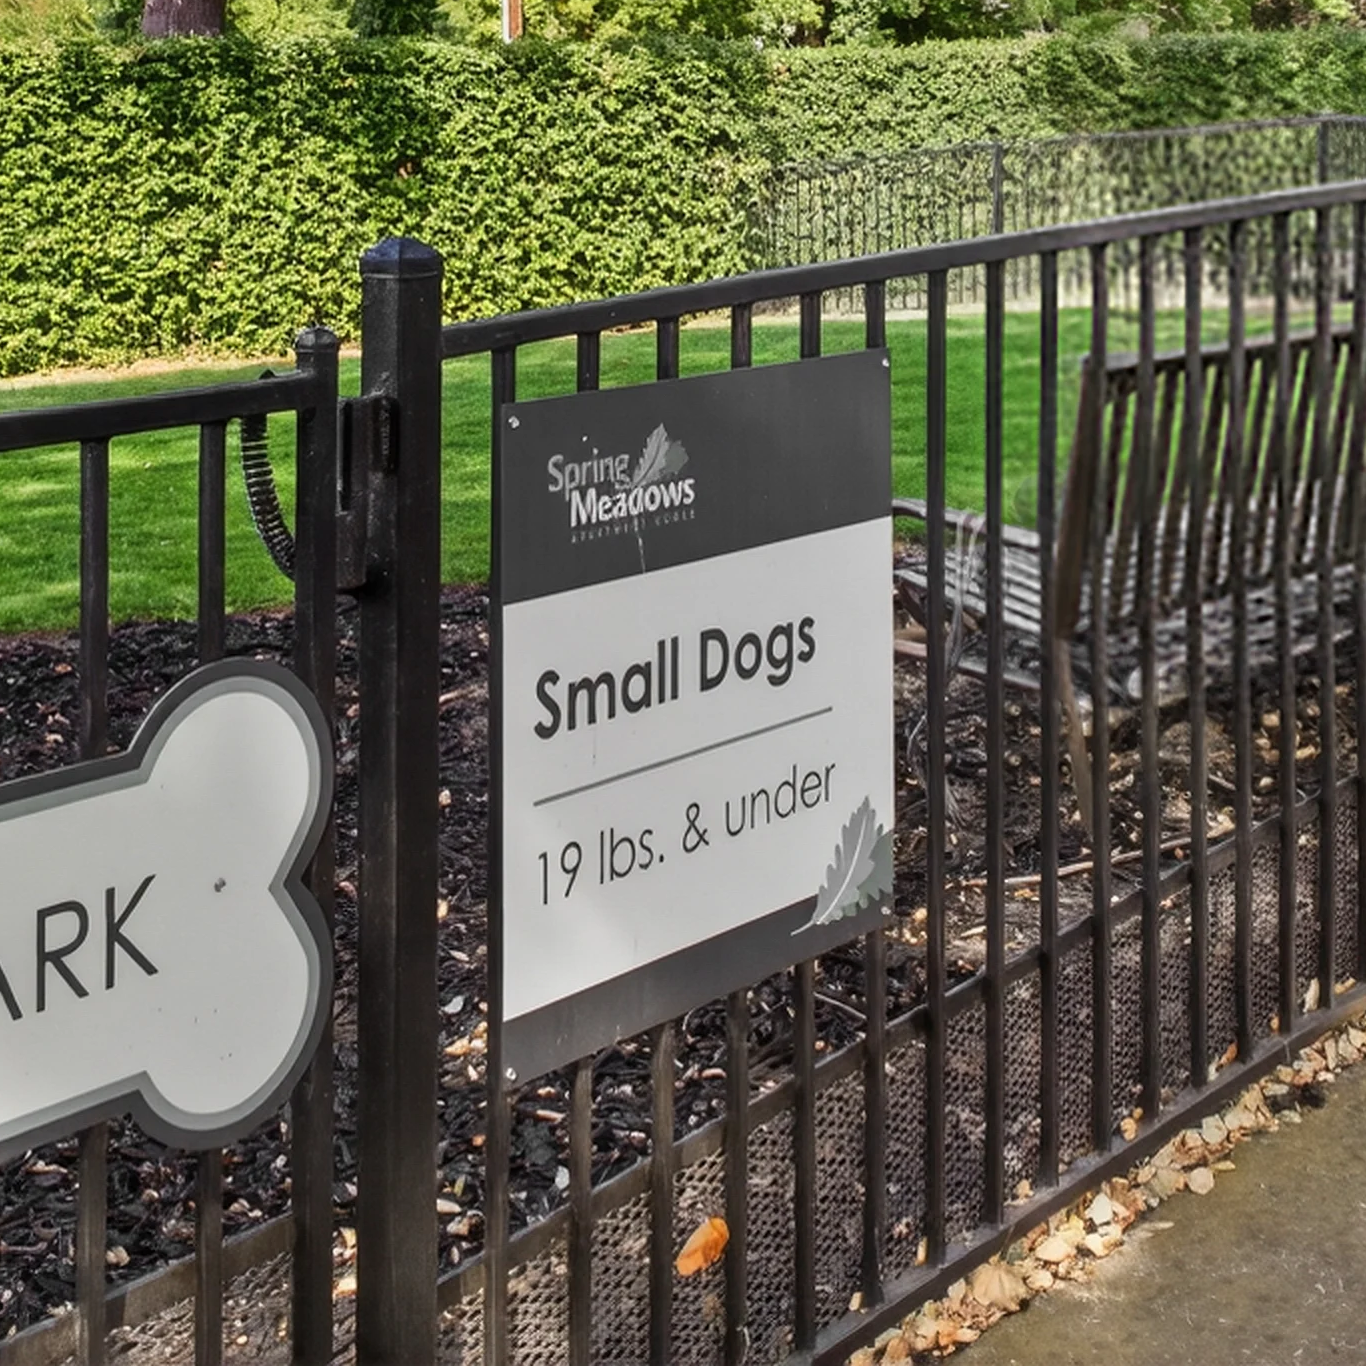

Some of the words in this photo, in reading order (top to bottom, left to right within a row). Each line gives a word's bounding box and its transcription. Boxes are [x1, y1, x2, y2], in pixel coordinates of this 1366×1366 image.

[547, 447, 633, 501] Spring
[570, 478, 696, 527] Meadows
[534, 635, 679, 739] Small
[700, 616, 816, 691] Dogs
[538, 841, 583, 905] 19
[599, 828, 665, 884] lbs.
[682, 802, 710, 853] &
[725, 764, 836, 837] under
